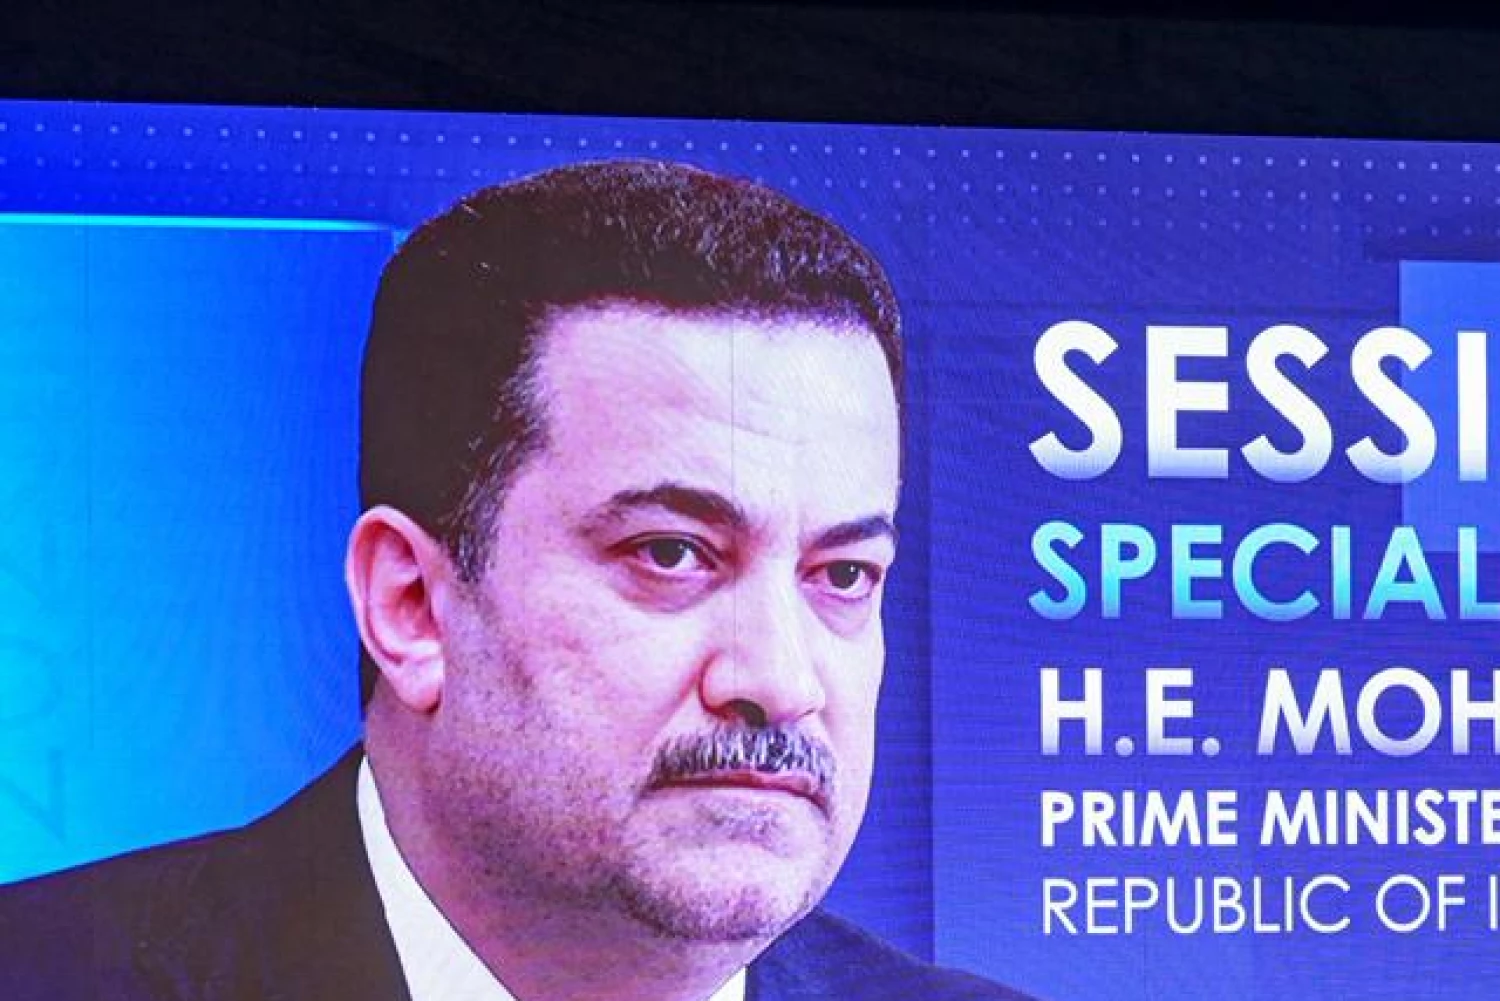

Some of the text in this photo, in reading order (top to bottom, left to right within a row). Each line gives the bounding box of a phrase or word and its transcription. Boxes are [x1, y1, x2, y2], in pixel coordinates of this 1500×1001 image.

[1028, 520, 1500, 621] SPECIAL
[1039, 667, 1222, 757] H.E.
[1040, 789, 1239, 848] PRIME
[1042, 873, 1352, 936] REPUBLIC
[1374, 873, 1467, 935] OF
